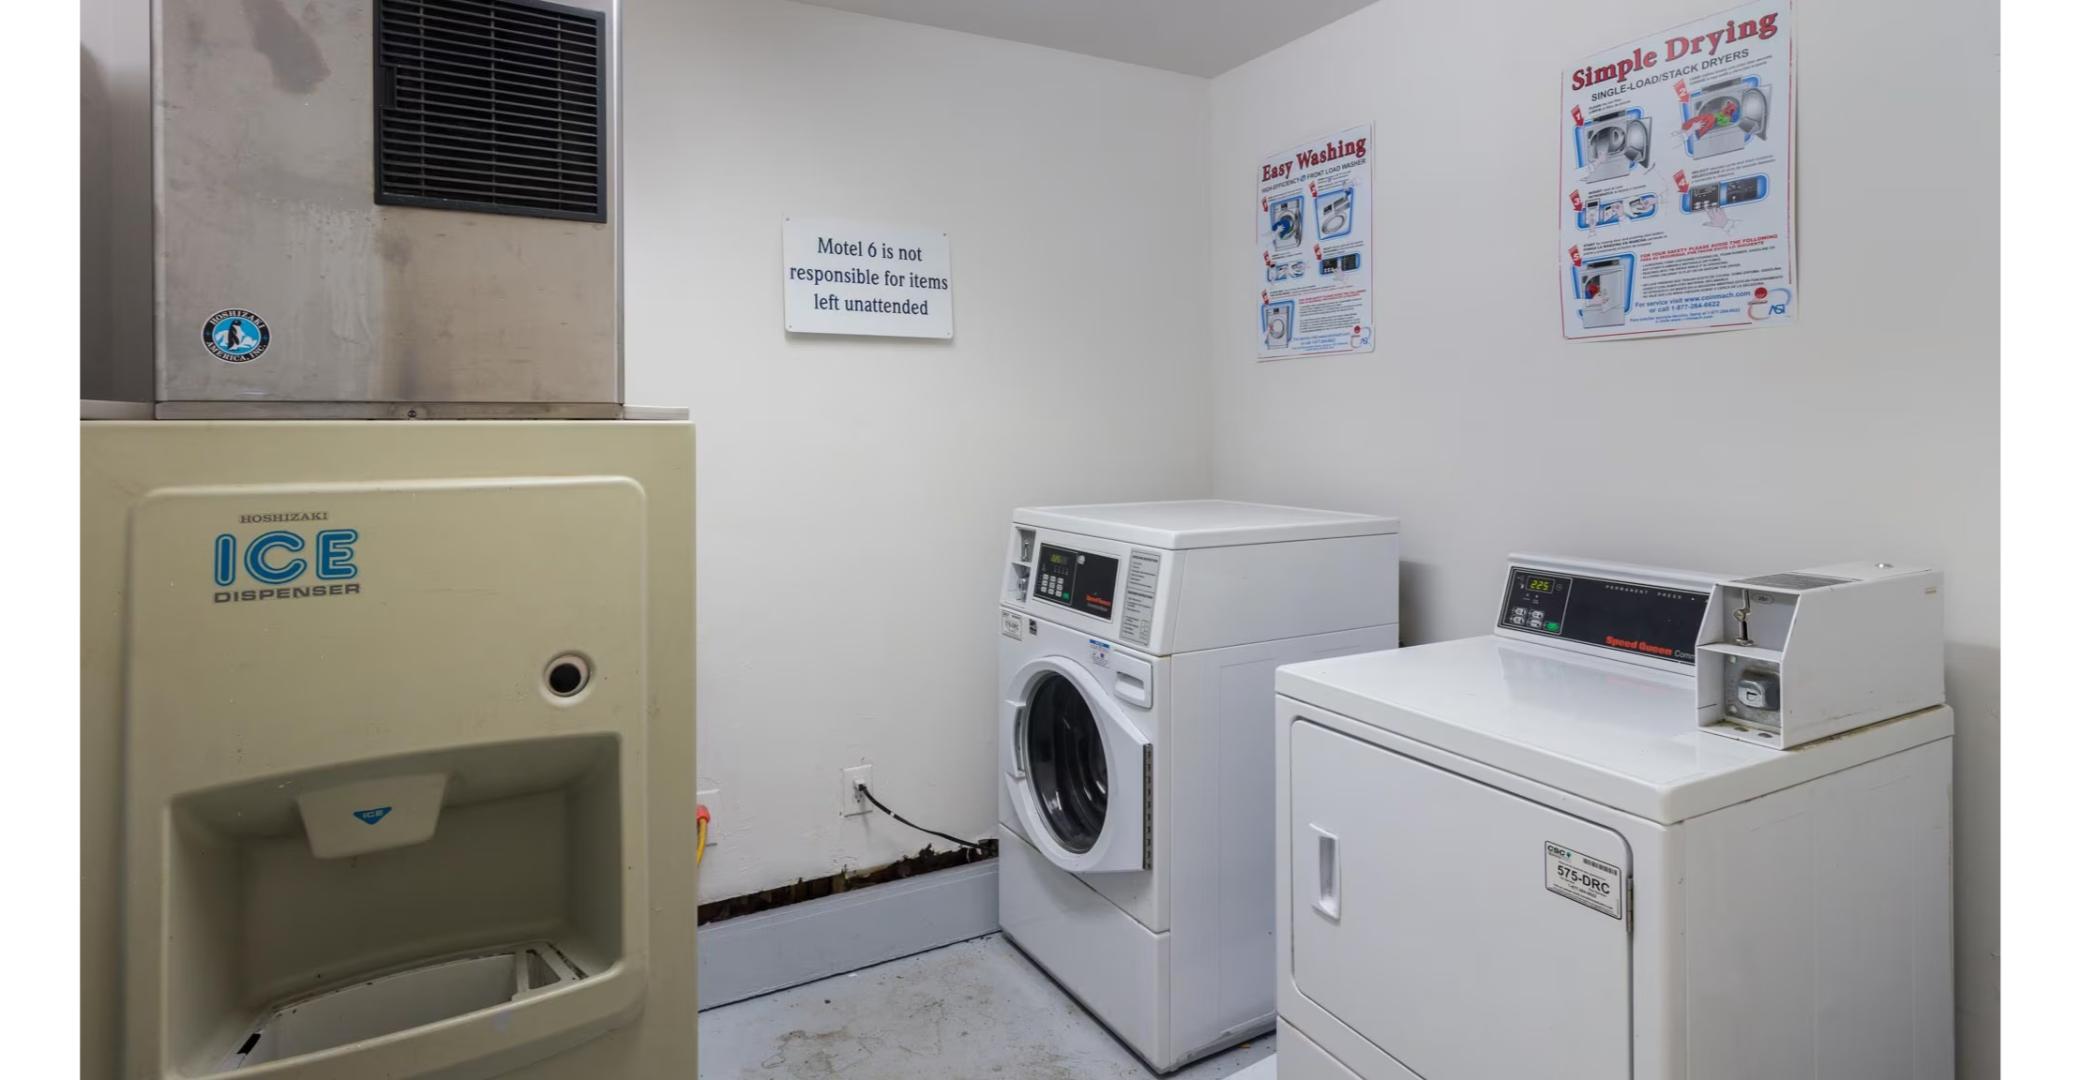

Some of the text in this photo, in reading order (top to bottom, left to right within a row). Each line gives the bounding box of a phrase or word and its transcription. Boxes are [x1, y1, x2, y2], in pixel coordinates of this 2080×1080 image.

[1572, 47, 1658, 91] Simple
[1664, 12, 1779, 62] Drying
[1591, 63, 1698, 102] SINGLE-LOAD/STACK
[1701, 48, 1750, 69] DRYERS
[1261, 160, 1294, 182] Easy
[1296, 137, 1367, 170] Washing
[1325, 165, 1341, 175] LOAD
[1341, 158, 1367, 170] WASHER
[817, 237, 923, 262] Motel 6 is not
[789, 266, 949, 290] responsible for items
[813, 293, 929, 316] left unattended
[1646, 299, 1669, 307] service
[209, 310, 266, 330] HOSHIZAKI
[239, 512, 329, 524] HOSHIZAKI
[214, 528, 359, 587] ICE
[214, 583, 361, 604] DISPENSER
[1530, 579, 1550, 591] 225
[1656, 591, 1683, 601] PRESS
[1606, 635, 1638, 650] Speed
[1638, 641, 1674, 657] Queen
[1557, 864, 1611, 896] 575-DRC
